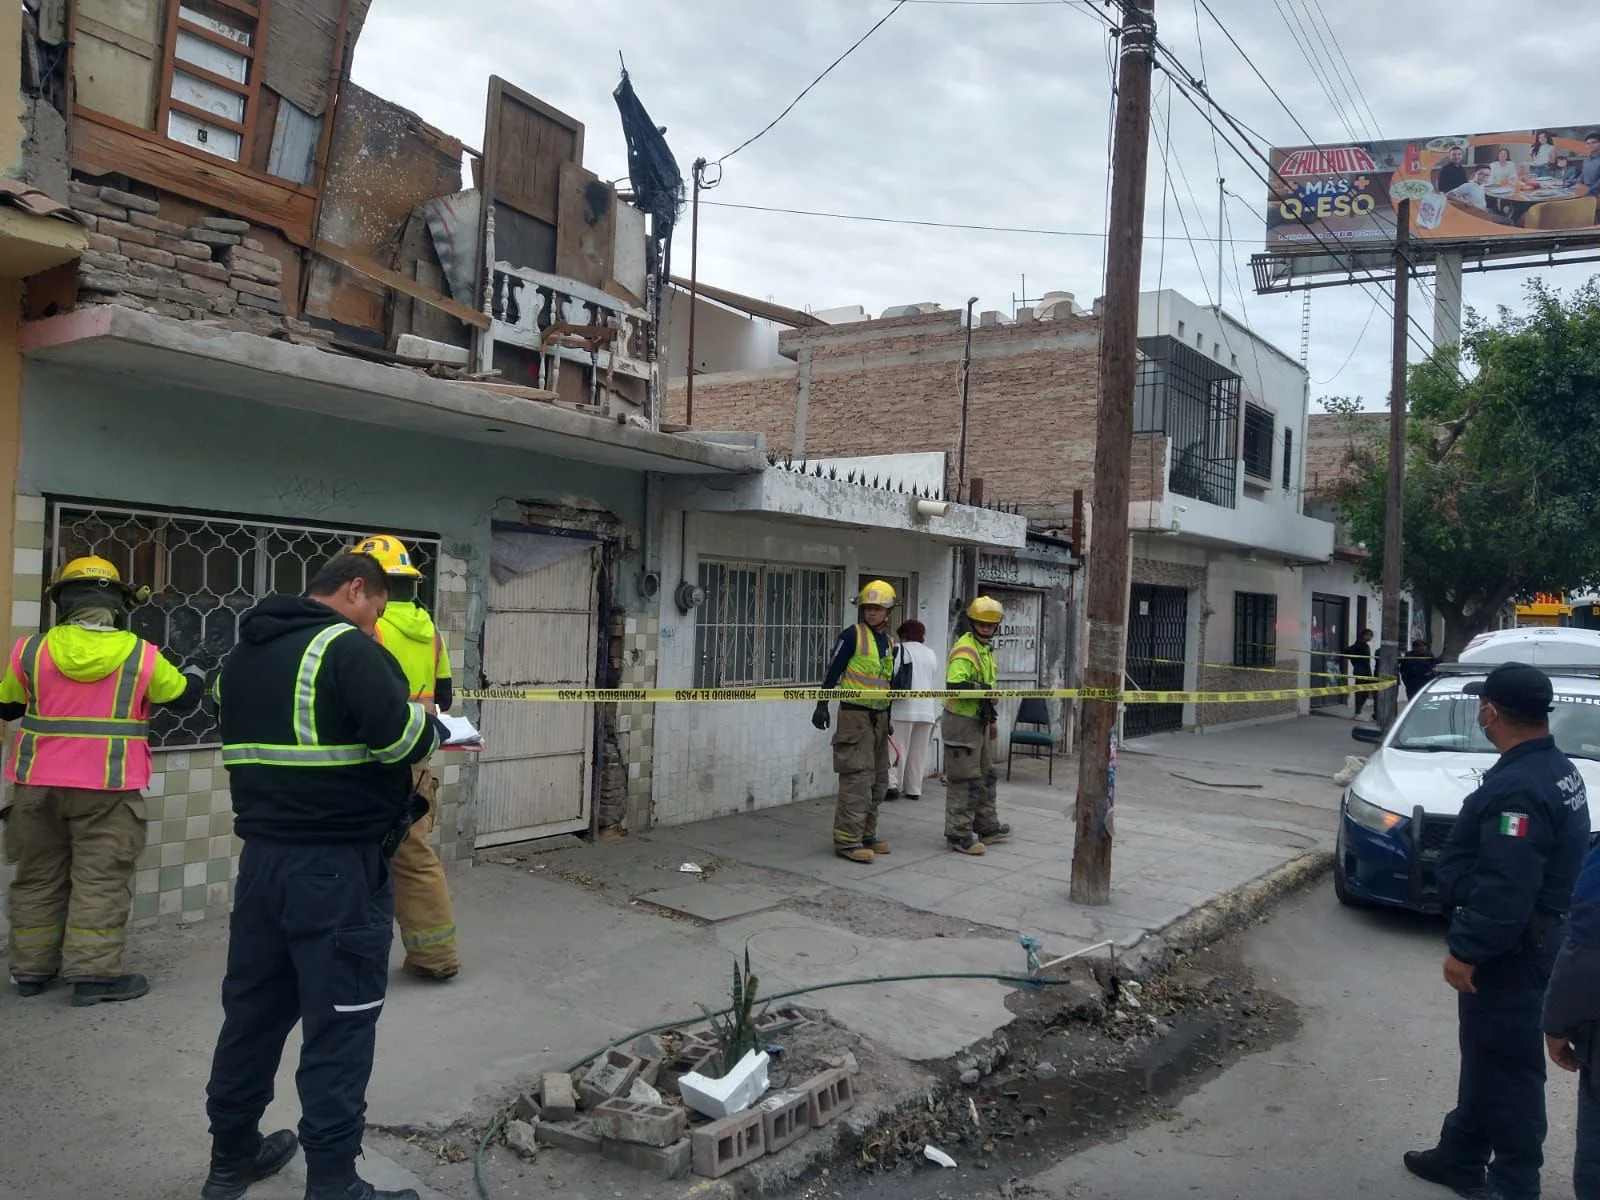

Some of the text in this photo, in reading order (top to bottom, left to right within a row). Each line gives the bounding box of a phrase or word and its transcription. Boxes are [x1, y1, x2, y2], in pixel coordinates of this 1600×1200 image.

[1306, 176, 1349, 195] MÁS
[558, 690, 647, 700] PROHIBIDO EL PASO
[675, 690, 757, 700] PROHIBIDO EL PASO
[783, 690, 861, 699] PROHIBIDO EL PASO
